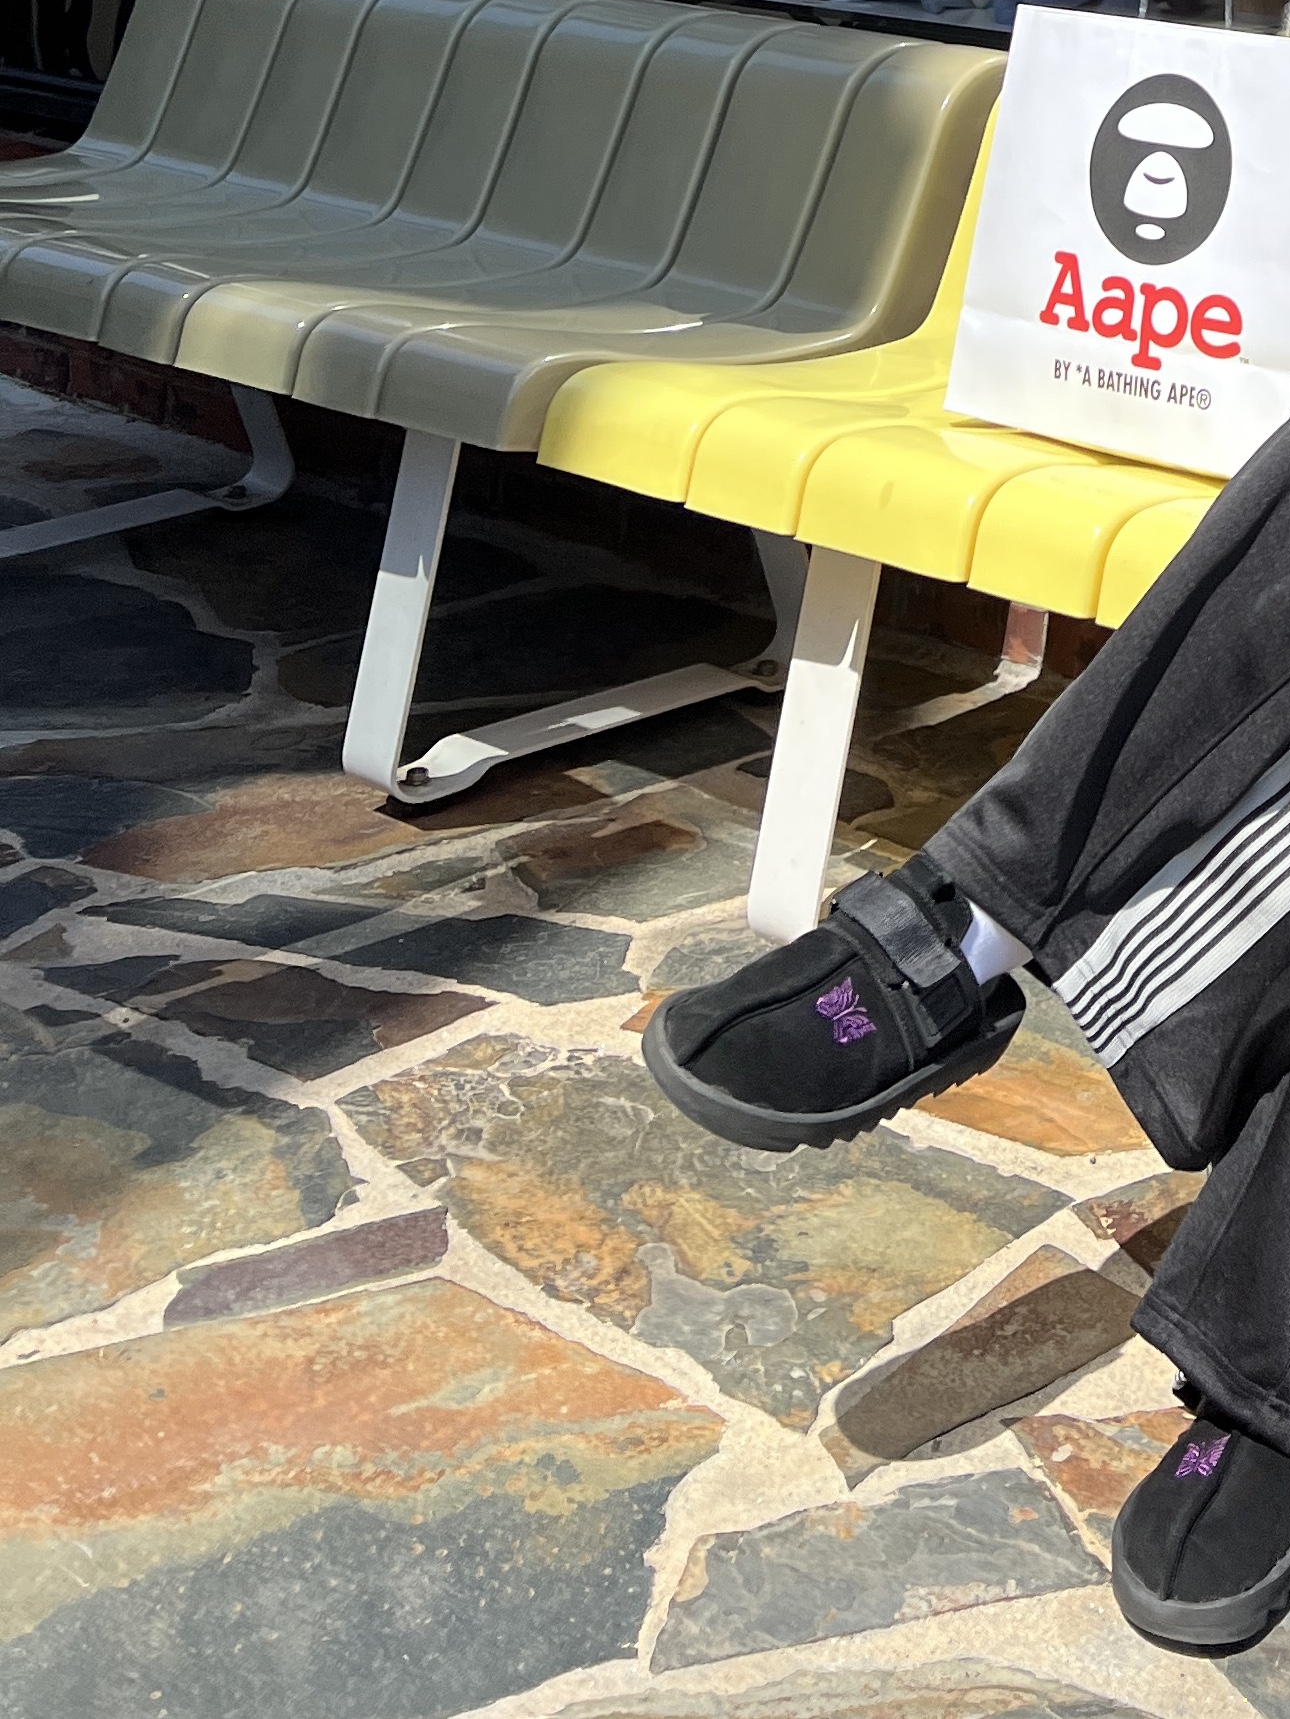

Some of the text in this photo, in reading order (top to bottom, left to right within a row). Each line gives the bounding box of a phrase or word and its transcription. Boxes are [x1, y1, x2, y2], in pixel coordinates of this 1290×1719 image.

[1040, 251, 1243, 369] Aape
[1054, 359, 1071, 381] BY
[1098, 370, 1161, 400] BATHING
